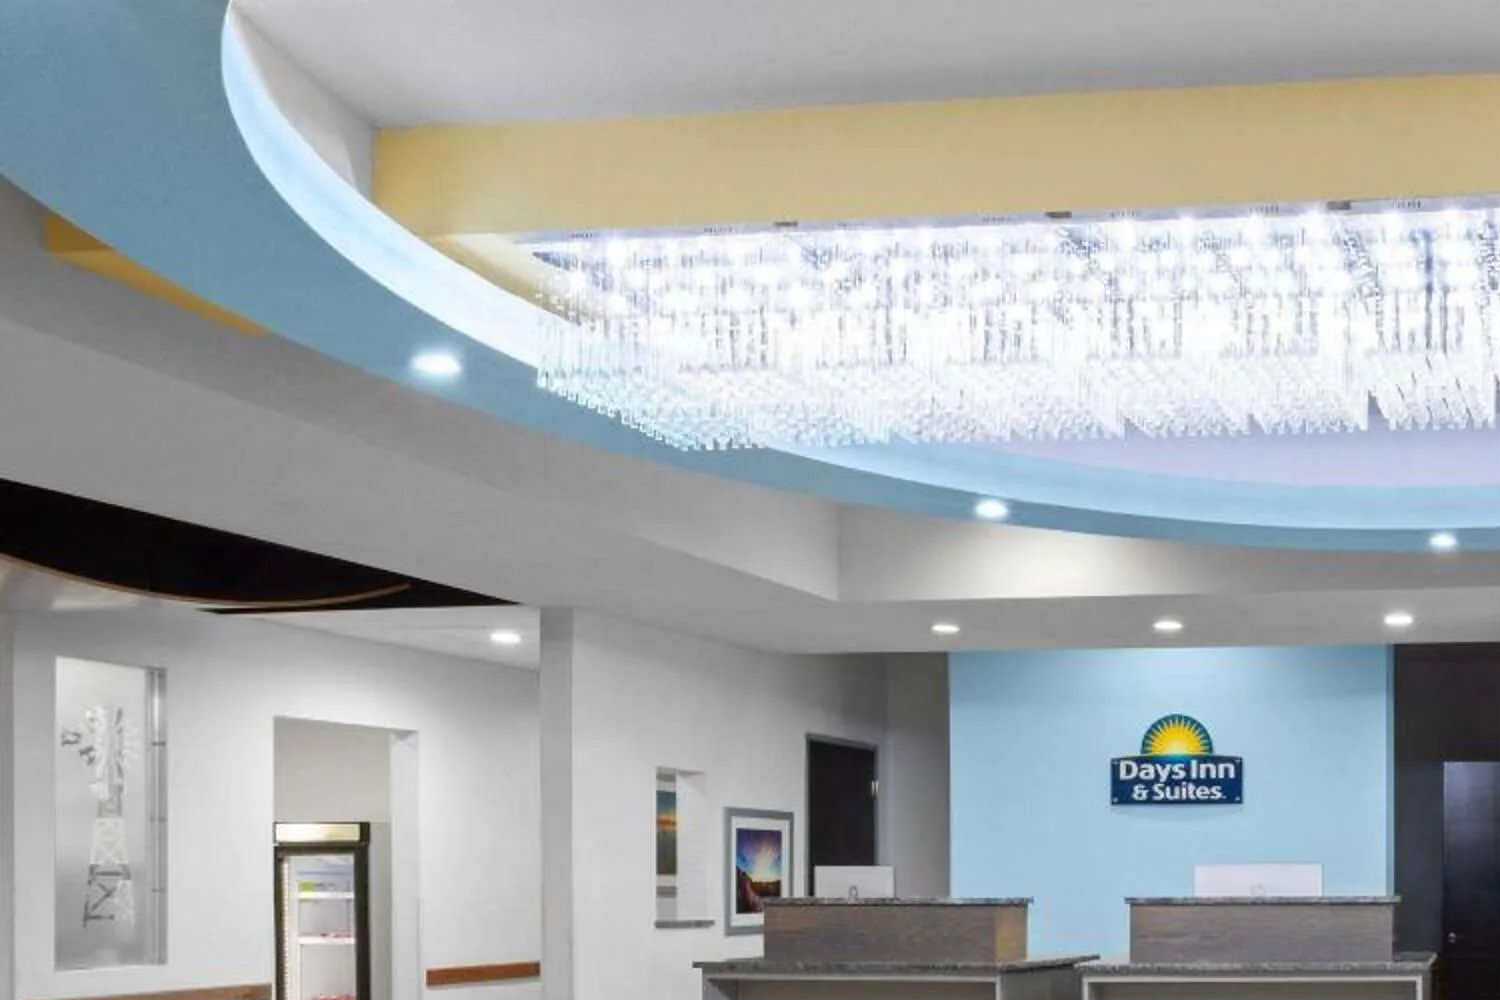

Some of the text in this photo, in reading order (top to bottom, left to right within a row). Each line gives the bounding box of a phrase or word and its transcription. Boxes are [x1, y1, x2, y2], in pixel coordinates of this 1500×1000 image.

[1119, 760, 1236, 782] Days Inn
[1132, 781, 1222, 801] & Suites
